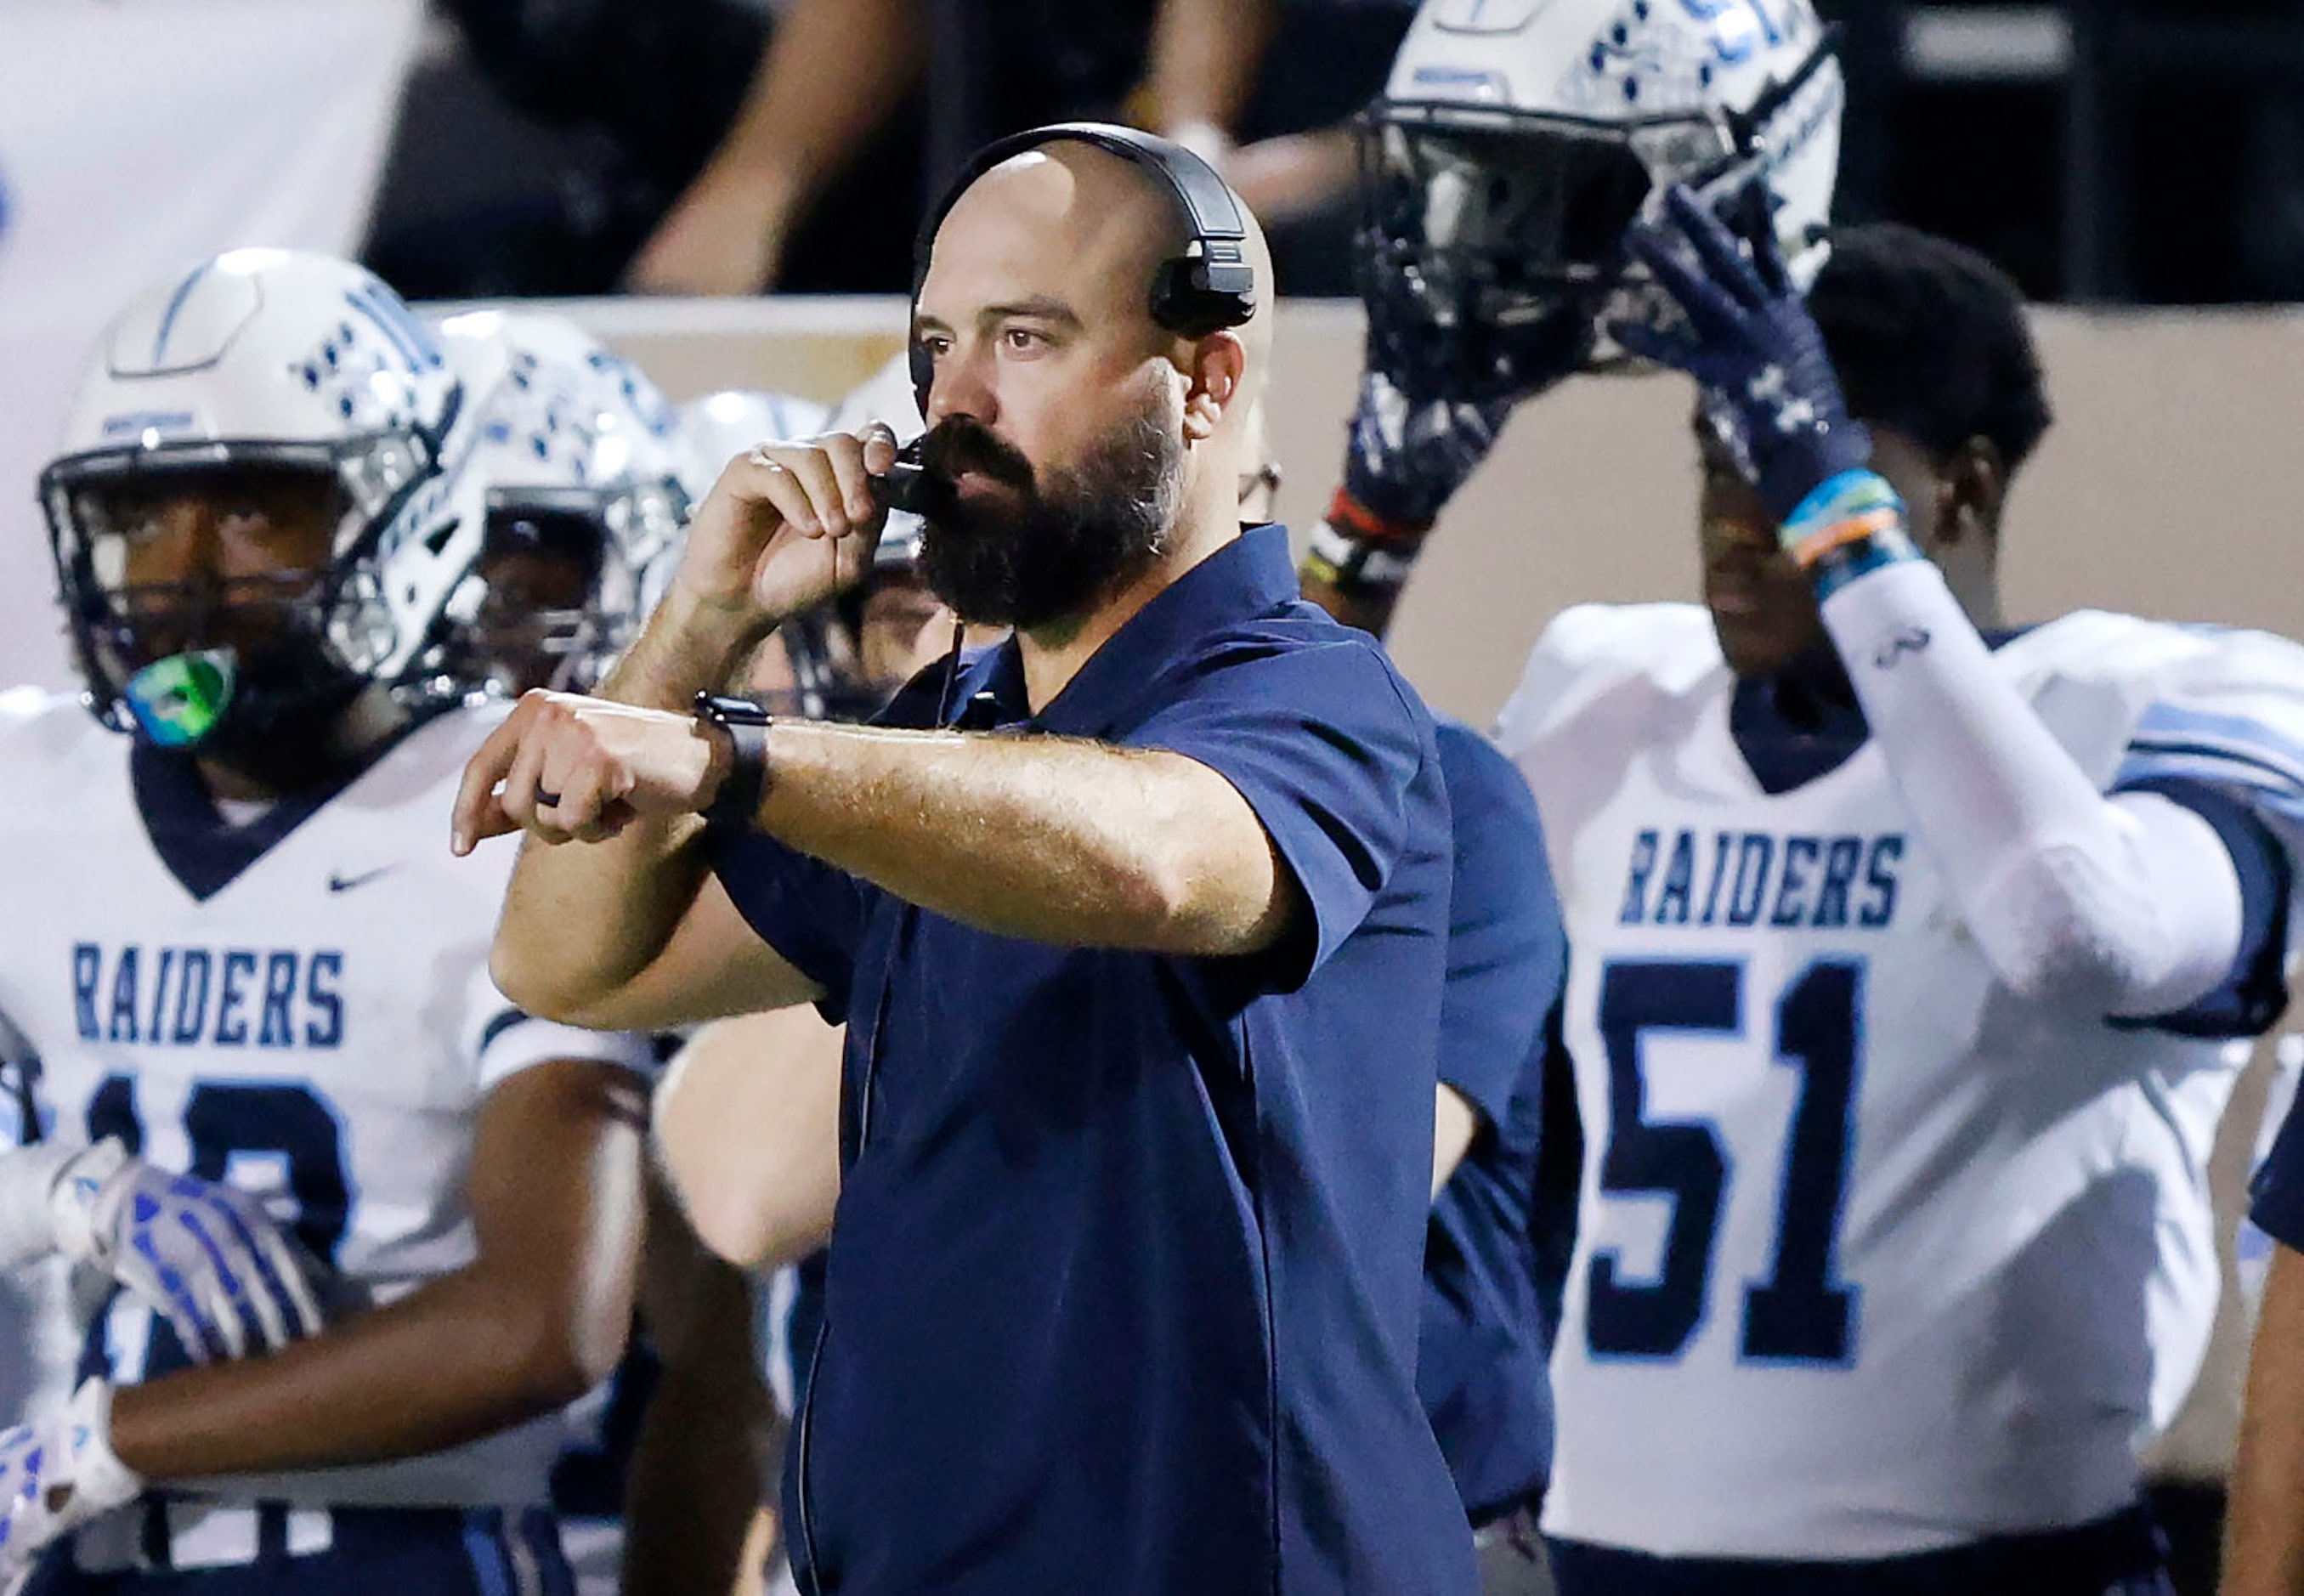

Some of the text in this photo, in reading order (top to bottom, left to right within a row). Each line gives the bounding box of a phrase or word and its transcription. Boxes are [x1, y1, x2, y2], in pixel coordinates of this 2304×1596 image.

[1618, 828, 1904, 928] RAIDERS
[73, 942, 344, 1049] RAIDERS
[1583, 954, 1866, 1370] 51
